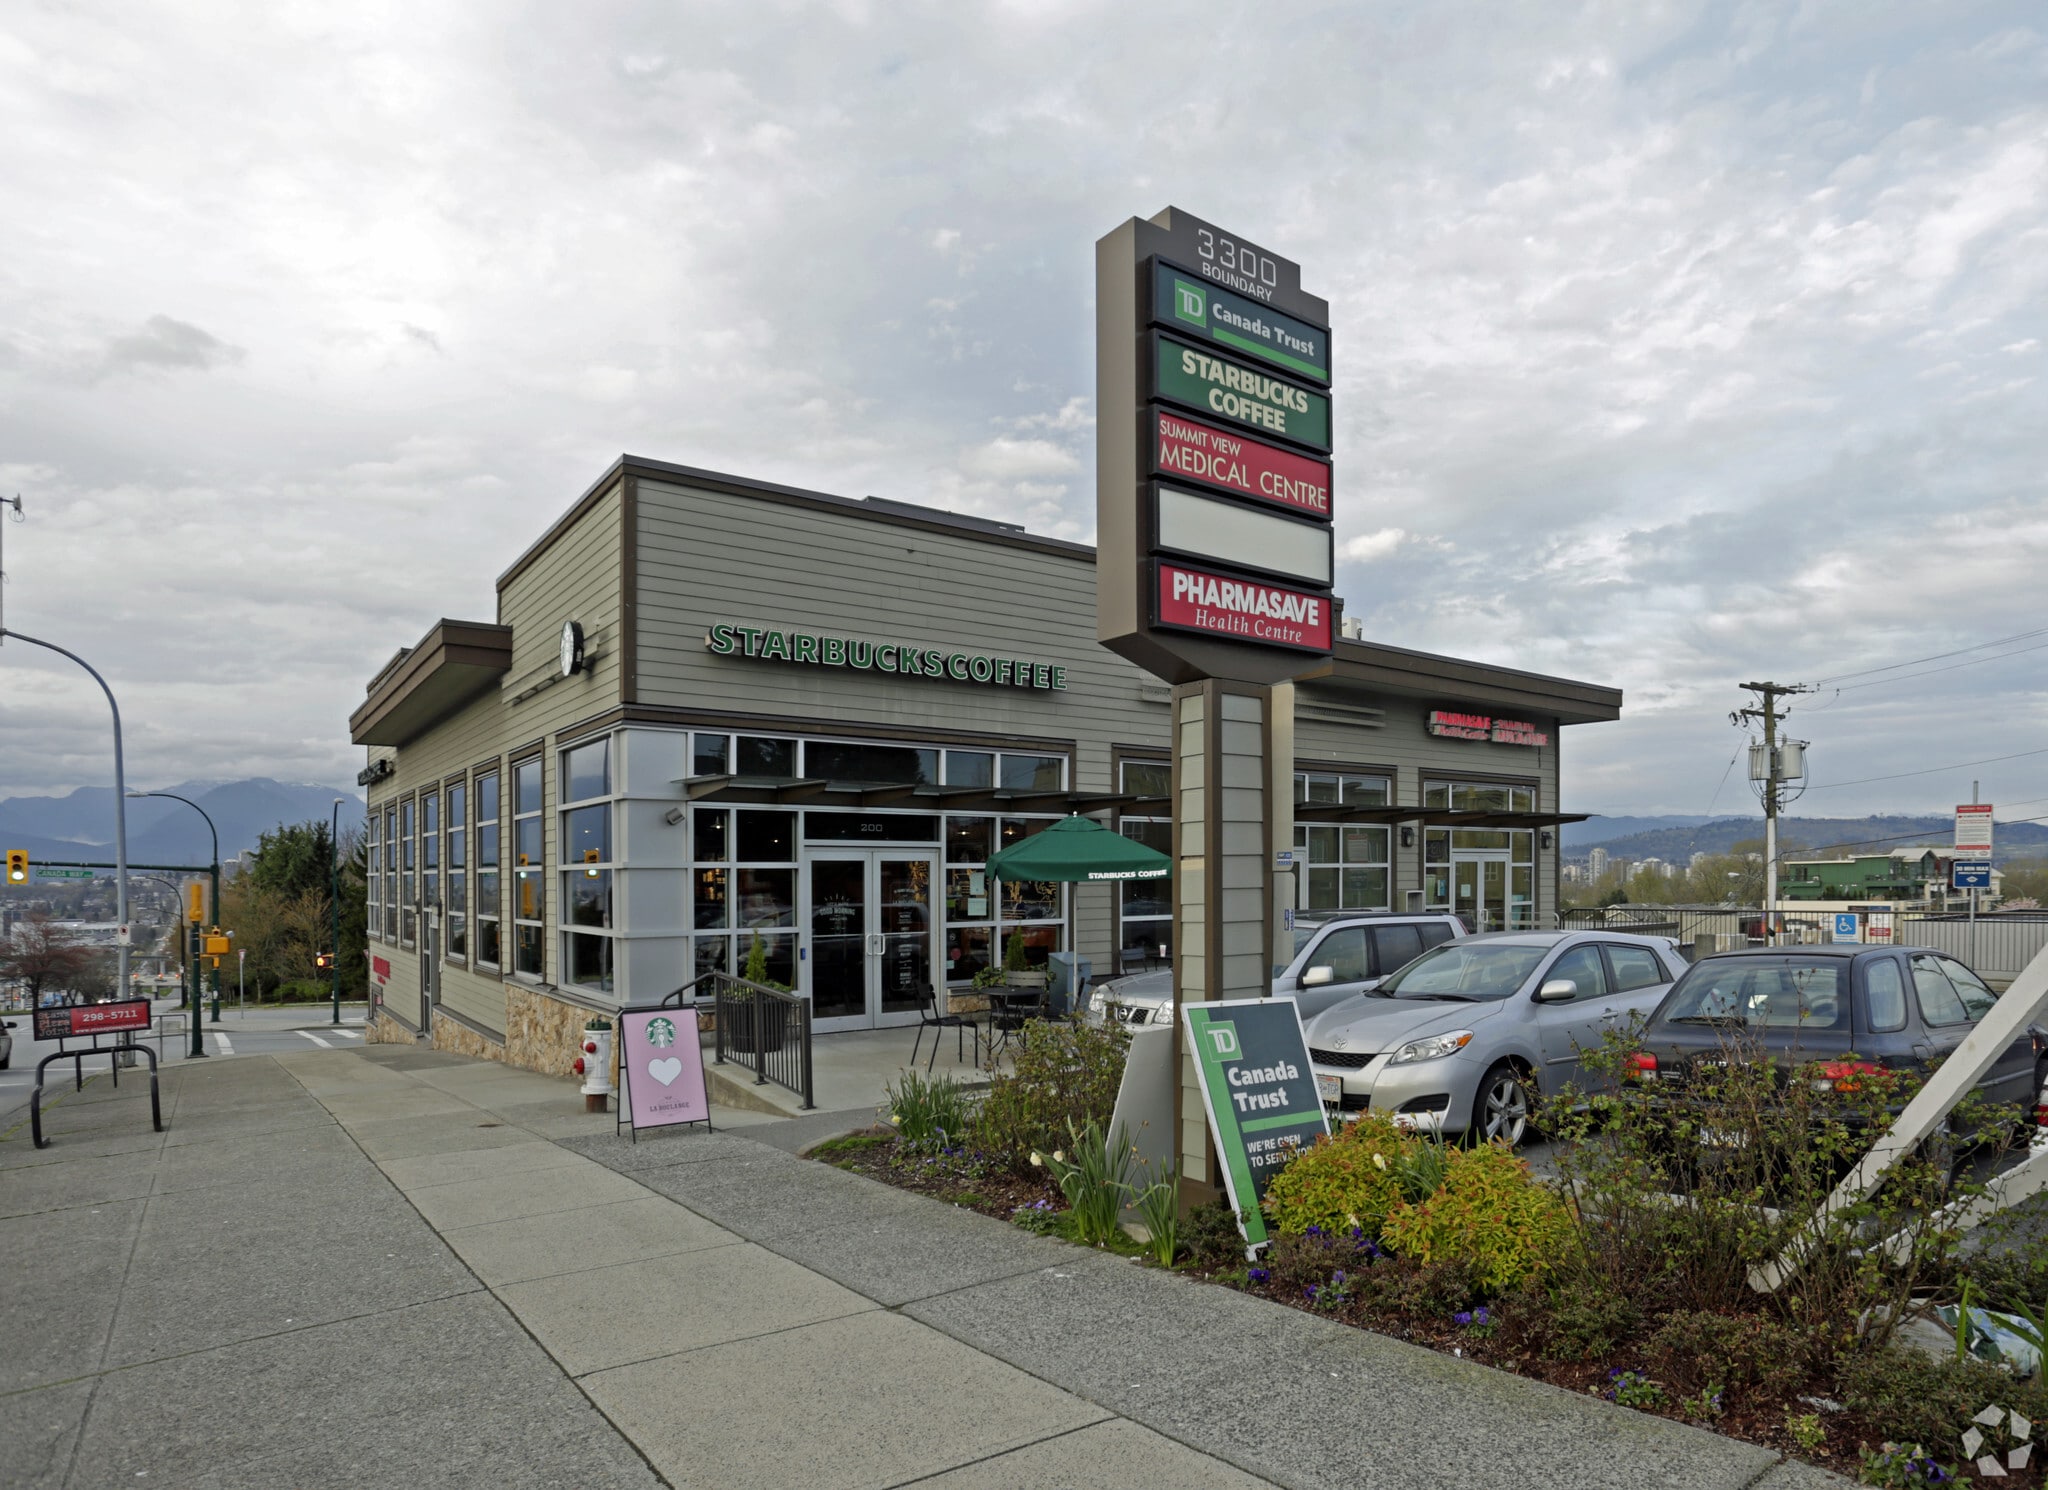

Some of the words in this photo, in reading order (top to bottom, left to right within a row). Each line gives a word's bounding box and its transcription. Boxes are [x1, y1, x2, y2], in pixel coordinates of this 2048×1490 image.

[1197, 228, 1277, 287] 3300
[1202, 261, 1272, 302] BOUNDARY
[1178, 287, 1204, 318] TD
[1212, 302, 1271, 339] Canada
[1273, 326, 1315, 357] Trust
[1182, 348, 1309, 414] STARBUCKS
[1208, 387, 1286, 433] COFFEE
[1160, 419, 1208, 448] SUMMIT
[1211, 434, 1241, 458] VIEW
[1160, 441, 1250, 489] MEDICAL
[1260, 471, 1327, 510] CENTRE
[1173, 571, 1319, 626] PHARMASAVE
[1195, 609, 1249, 633] Health
[1254, 619, 1302, 642] Centre
[861, 823, 883, 832] 200
[1088, 871, 1136, 879] STARBUCKS
[1137, 869, 1167, 878] COFFEE
[83, 1010, 138, 1022] 298-5711
[1207, 1028, 1236, 1053] TD
[1227, 1060, 1299, 1086] Canada
[1233, 1087, 1290, 1112] Trust
[1247, 1138, 1277, 1154] WE'RE
[1250, 1155, 1264, 1168] TO
